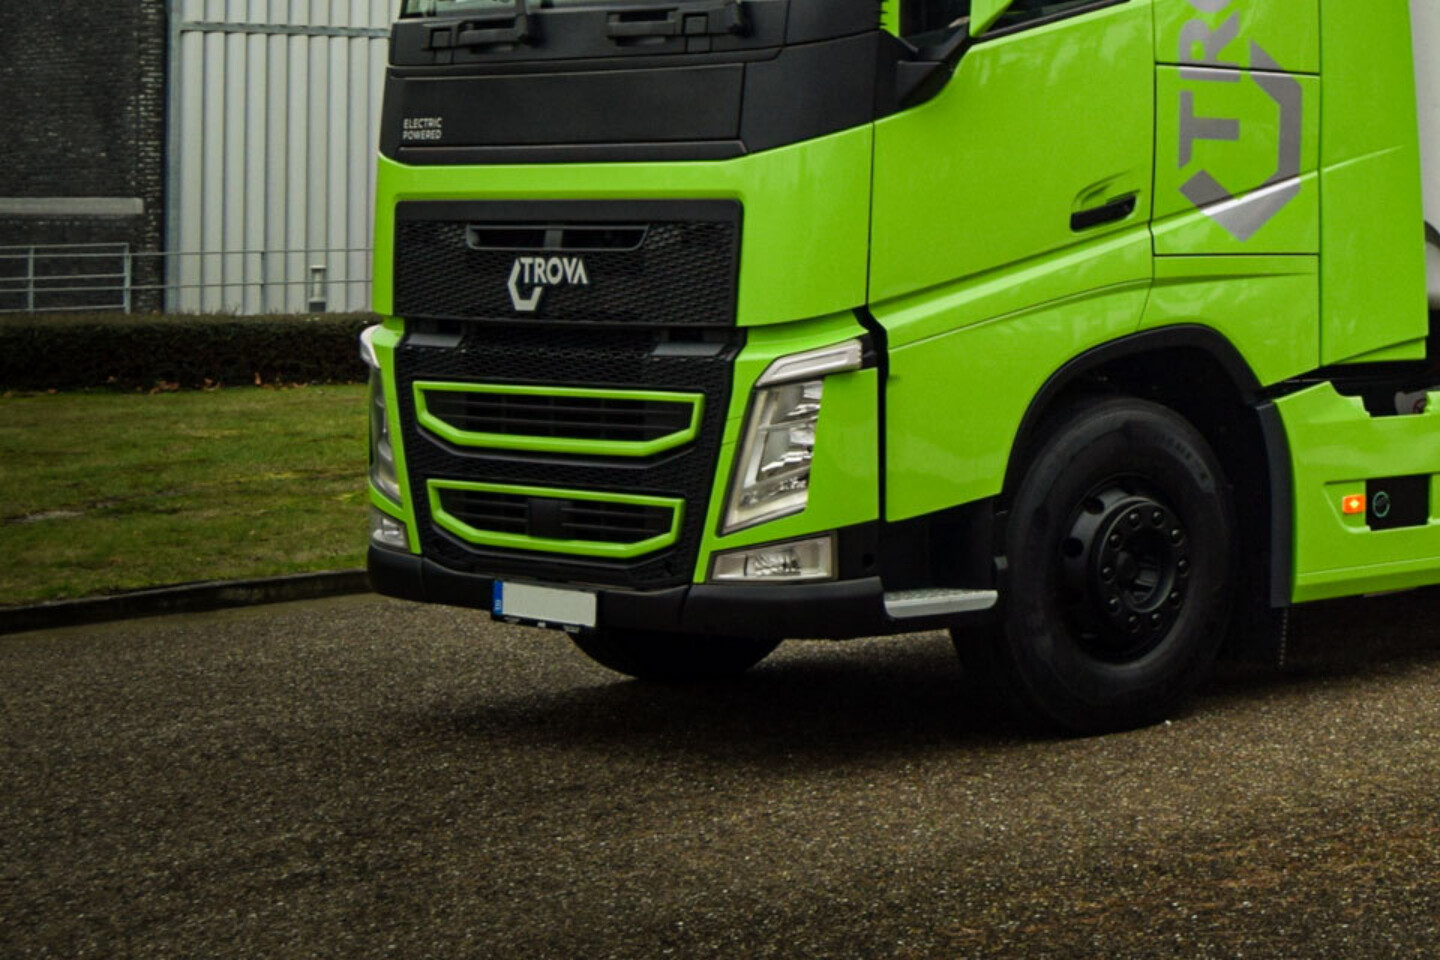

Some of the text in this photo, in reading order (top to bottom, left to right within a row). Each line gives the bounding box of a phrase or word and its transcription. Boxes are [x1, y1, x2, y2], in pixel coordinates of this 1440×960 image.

[403, 117, 442, 129] ELECTRIC
[403, 130, 442, 140] POWERED
[519, 256, 589, 285] TROVA
